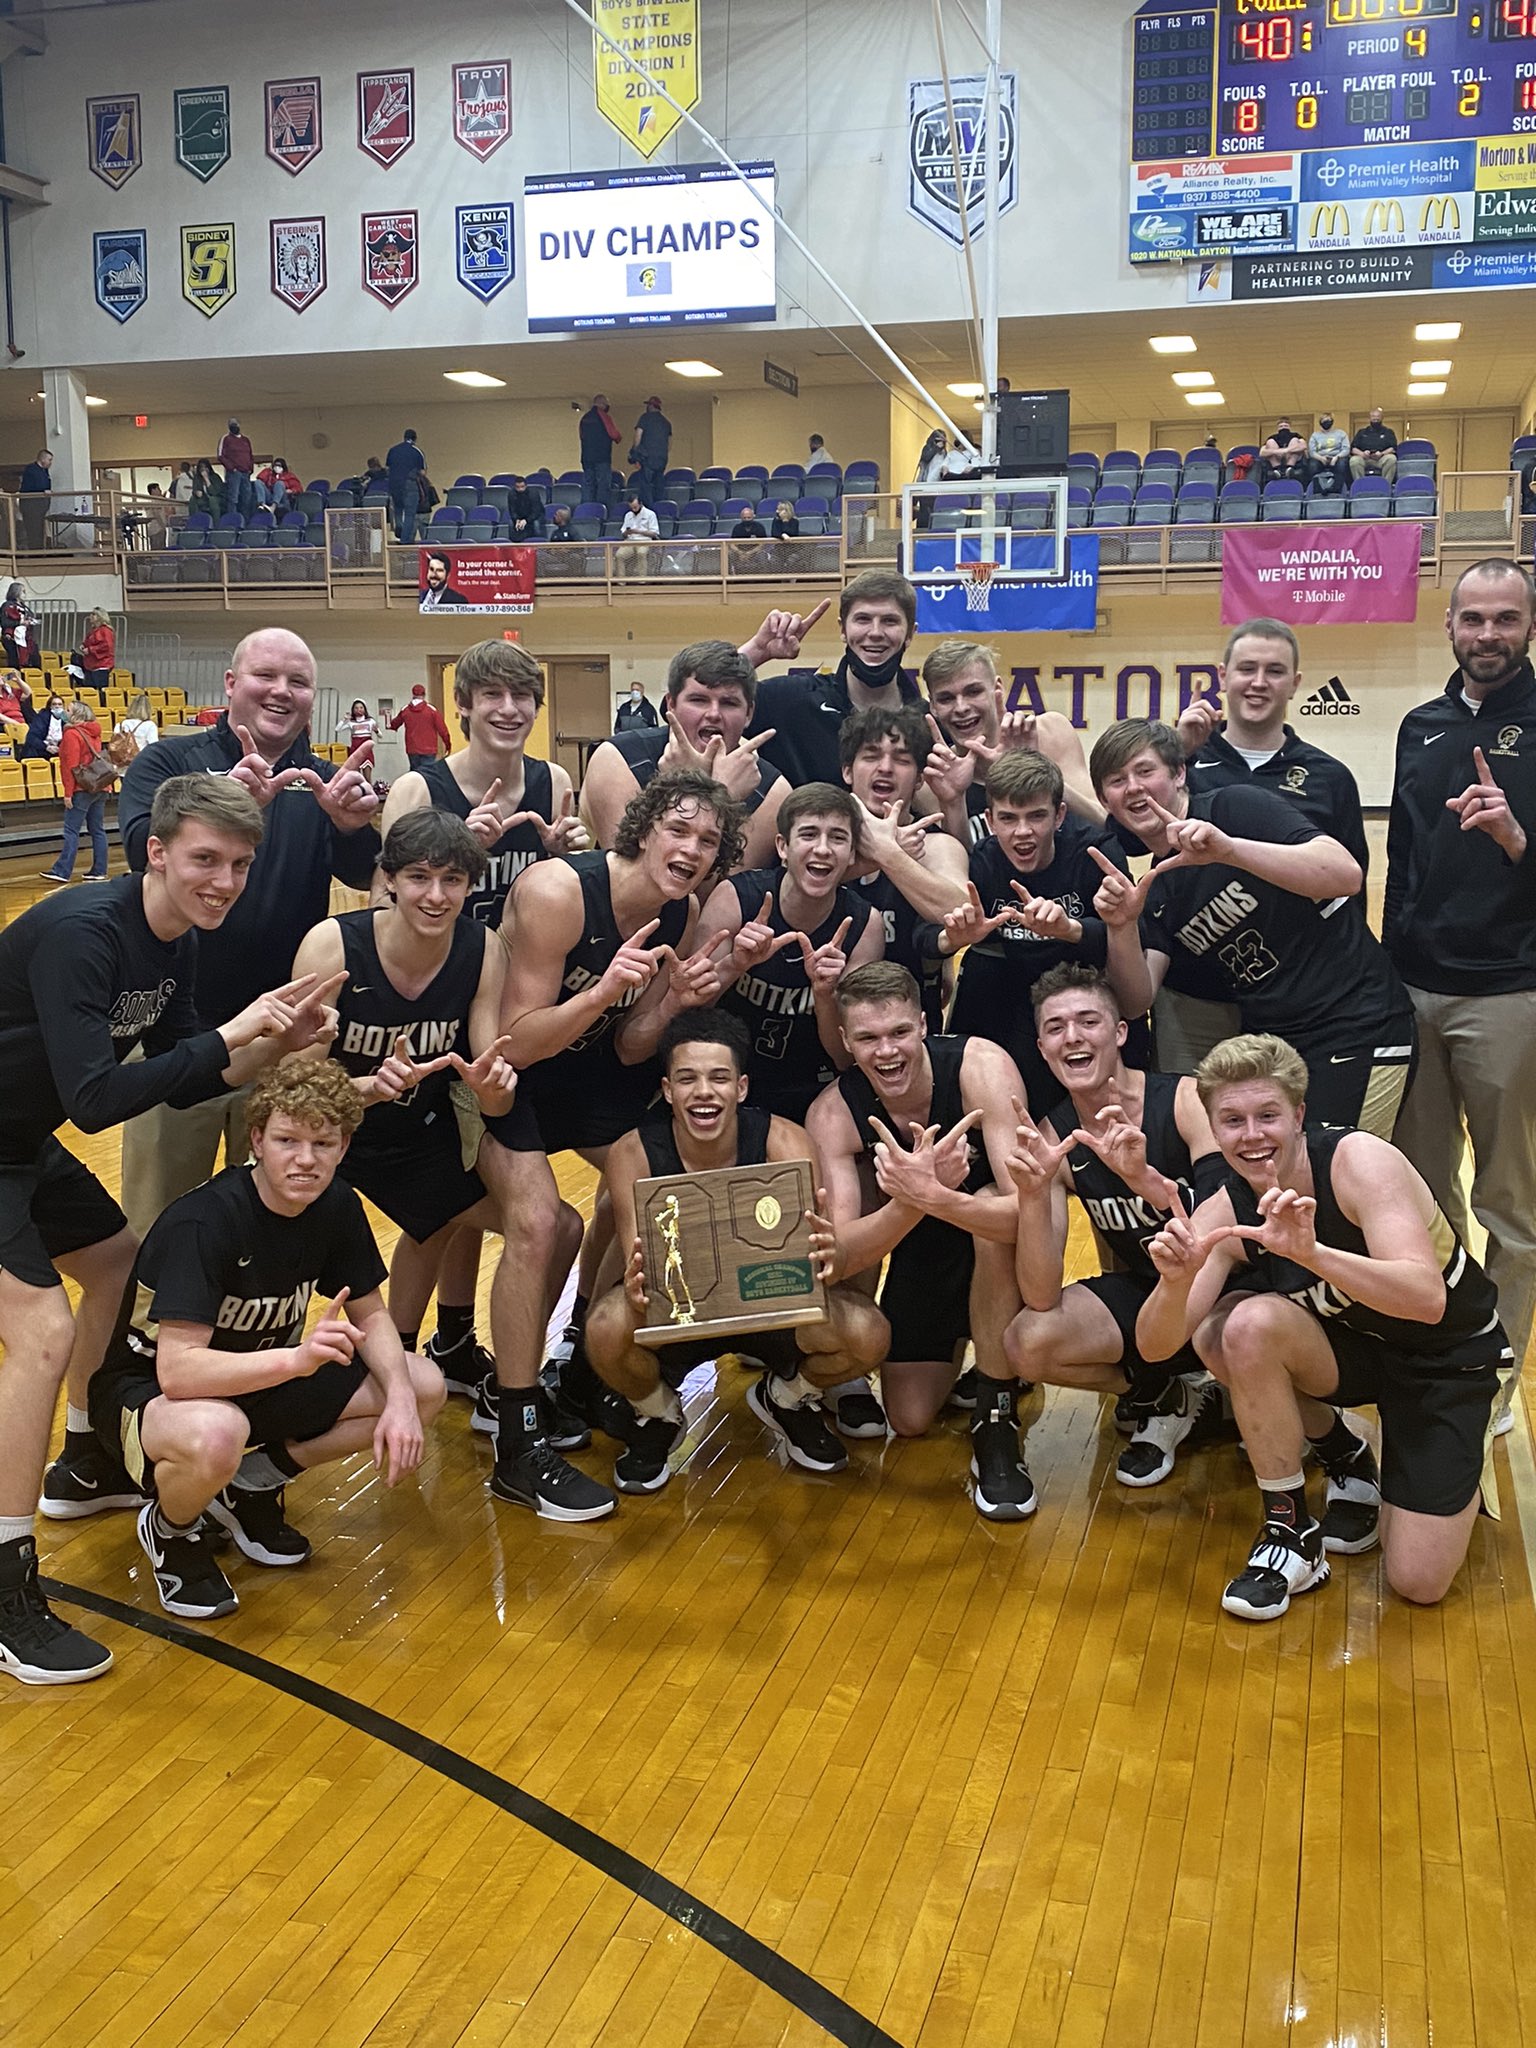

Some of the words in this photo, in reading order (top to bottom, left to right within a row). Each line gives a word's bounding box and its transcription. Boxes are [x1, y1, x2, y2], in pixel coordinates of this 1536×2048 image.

[622, 13, 670, 30] STATE
[1140, 18, 1160, 30] PLYR
[1167, 16, 1181, 29] FLS
[1191, 15, 1206, 27] PTS
[1240, 17, 1292, 62] 40
[1347, 37, 1399, 56] PERIOD
[1404, 28, 1426, 58] 4
[460, 69, 503, 80] TROY
[1343, 75, 1396, 93] PLAYER
[1400, 72, 1436, 88] FOUL
[1452, 67, 1492, 84] T.O.L.
[1223, 85, 1266, 101] FOULS
[1290, 82, 1329, 97] T.O.L.
[458, 99, 507, 118] Trojans
[1458, 85, 1480, 117] 2
[1297, 97, 1317, 129] 0
[1363, 126, 1410, 142] MATCH
[1221, 138, 1264, 153] SCORE
[1480, 146, 1516, 168] Morton
[1518, 147, 1525, 165] &
[1348, 159, 1399, 177] Premier
[1404, 155, 1459, 172] Health
[1183, 180, 1219, 188] Alliance
[1223, 176, 1256, 186] Realty,
[1260, 175, 1276, 184] Inc.
[1348, 177, 1374, 189] Miami
[1376, 175, 1403, 189] Valley
[1405, 171, 1452, 186] Hospital
[1183, 192, 1207, 202] (937)
[1211, 189, 1260, 200] 898-4400
[463, 211, 507, 223] XENIA
[1201, 216, 1233, 229] WE
[1241, 213, 1282, 227] ARE
[187, 232, 228, 242] SIDNEY
[276, 225, 319, 236] STEBBINS
[1201, 224, 1282, 241] TRUCKS!
[1418, 231, 1461, 242] VANDALIA
[1479, 225, 1513, 237] Serving
[539, 229, 595, 260] DIV
[607, 218, 760, 256] CHAMPS
[1308, 238, 1350, 248] VANDALIA
[1363, 235, 1406, 246] VANDALIA
[1200, 247, 1231, 257] DAYTON
[1474, 253, 1525, 267] Premier
[1251, 260, 1333, 274] PARTNERING
[1338, 258, 1355, 270] TO
[1360, 255, 1400, 268] BUILD
[1404, 255, 1414, 266] A
[1474, 266, 1501, 276] Miami
[1503, 265, 1528, 275] Valley
[1252, 275, 1322, 289] HEALTHIER
[1328, 270, 1412, 285] COMMUNITY
[457, 560, 464, 568] In
[465, 561, 481, 569] your
[483, 560, 507, 568] corner
[1281, 549, 1360, 565] VANDALIA,
[1258, 568, 1306, 582] WE'RE
[1309, 566, 1347, 581] WITH
[1351, 565, 1383, 579] YOU
[1299, 701, 1360, 715] adidas
[736, 973, 815, 1016] BOTKI
[343, 1019, 459, 1057] BOTKINS
[755, 1018, 793, 1060] 3
